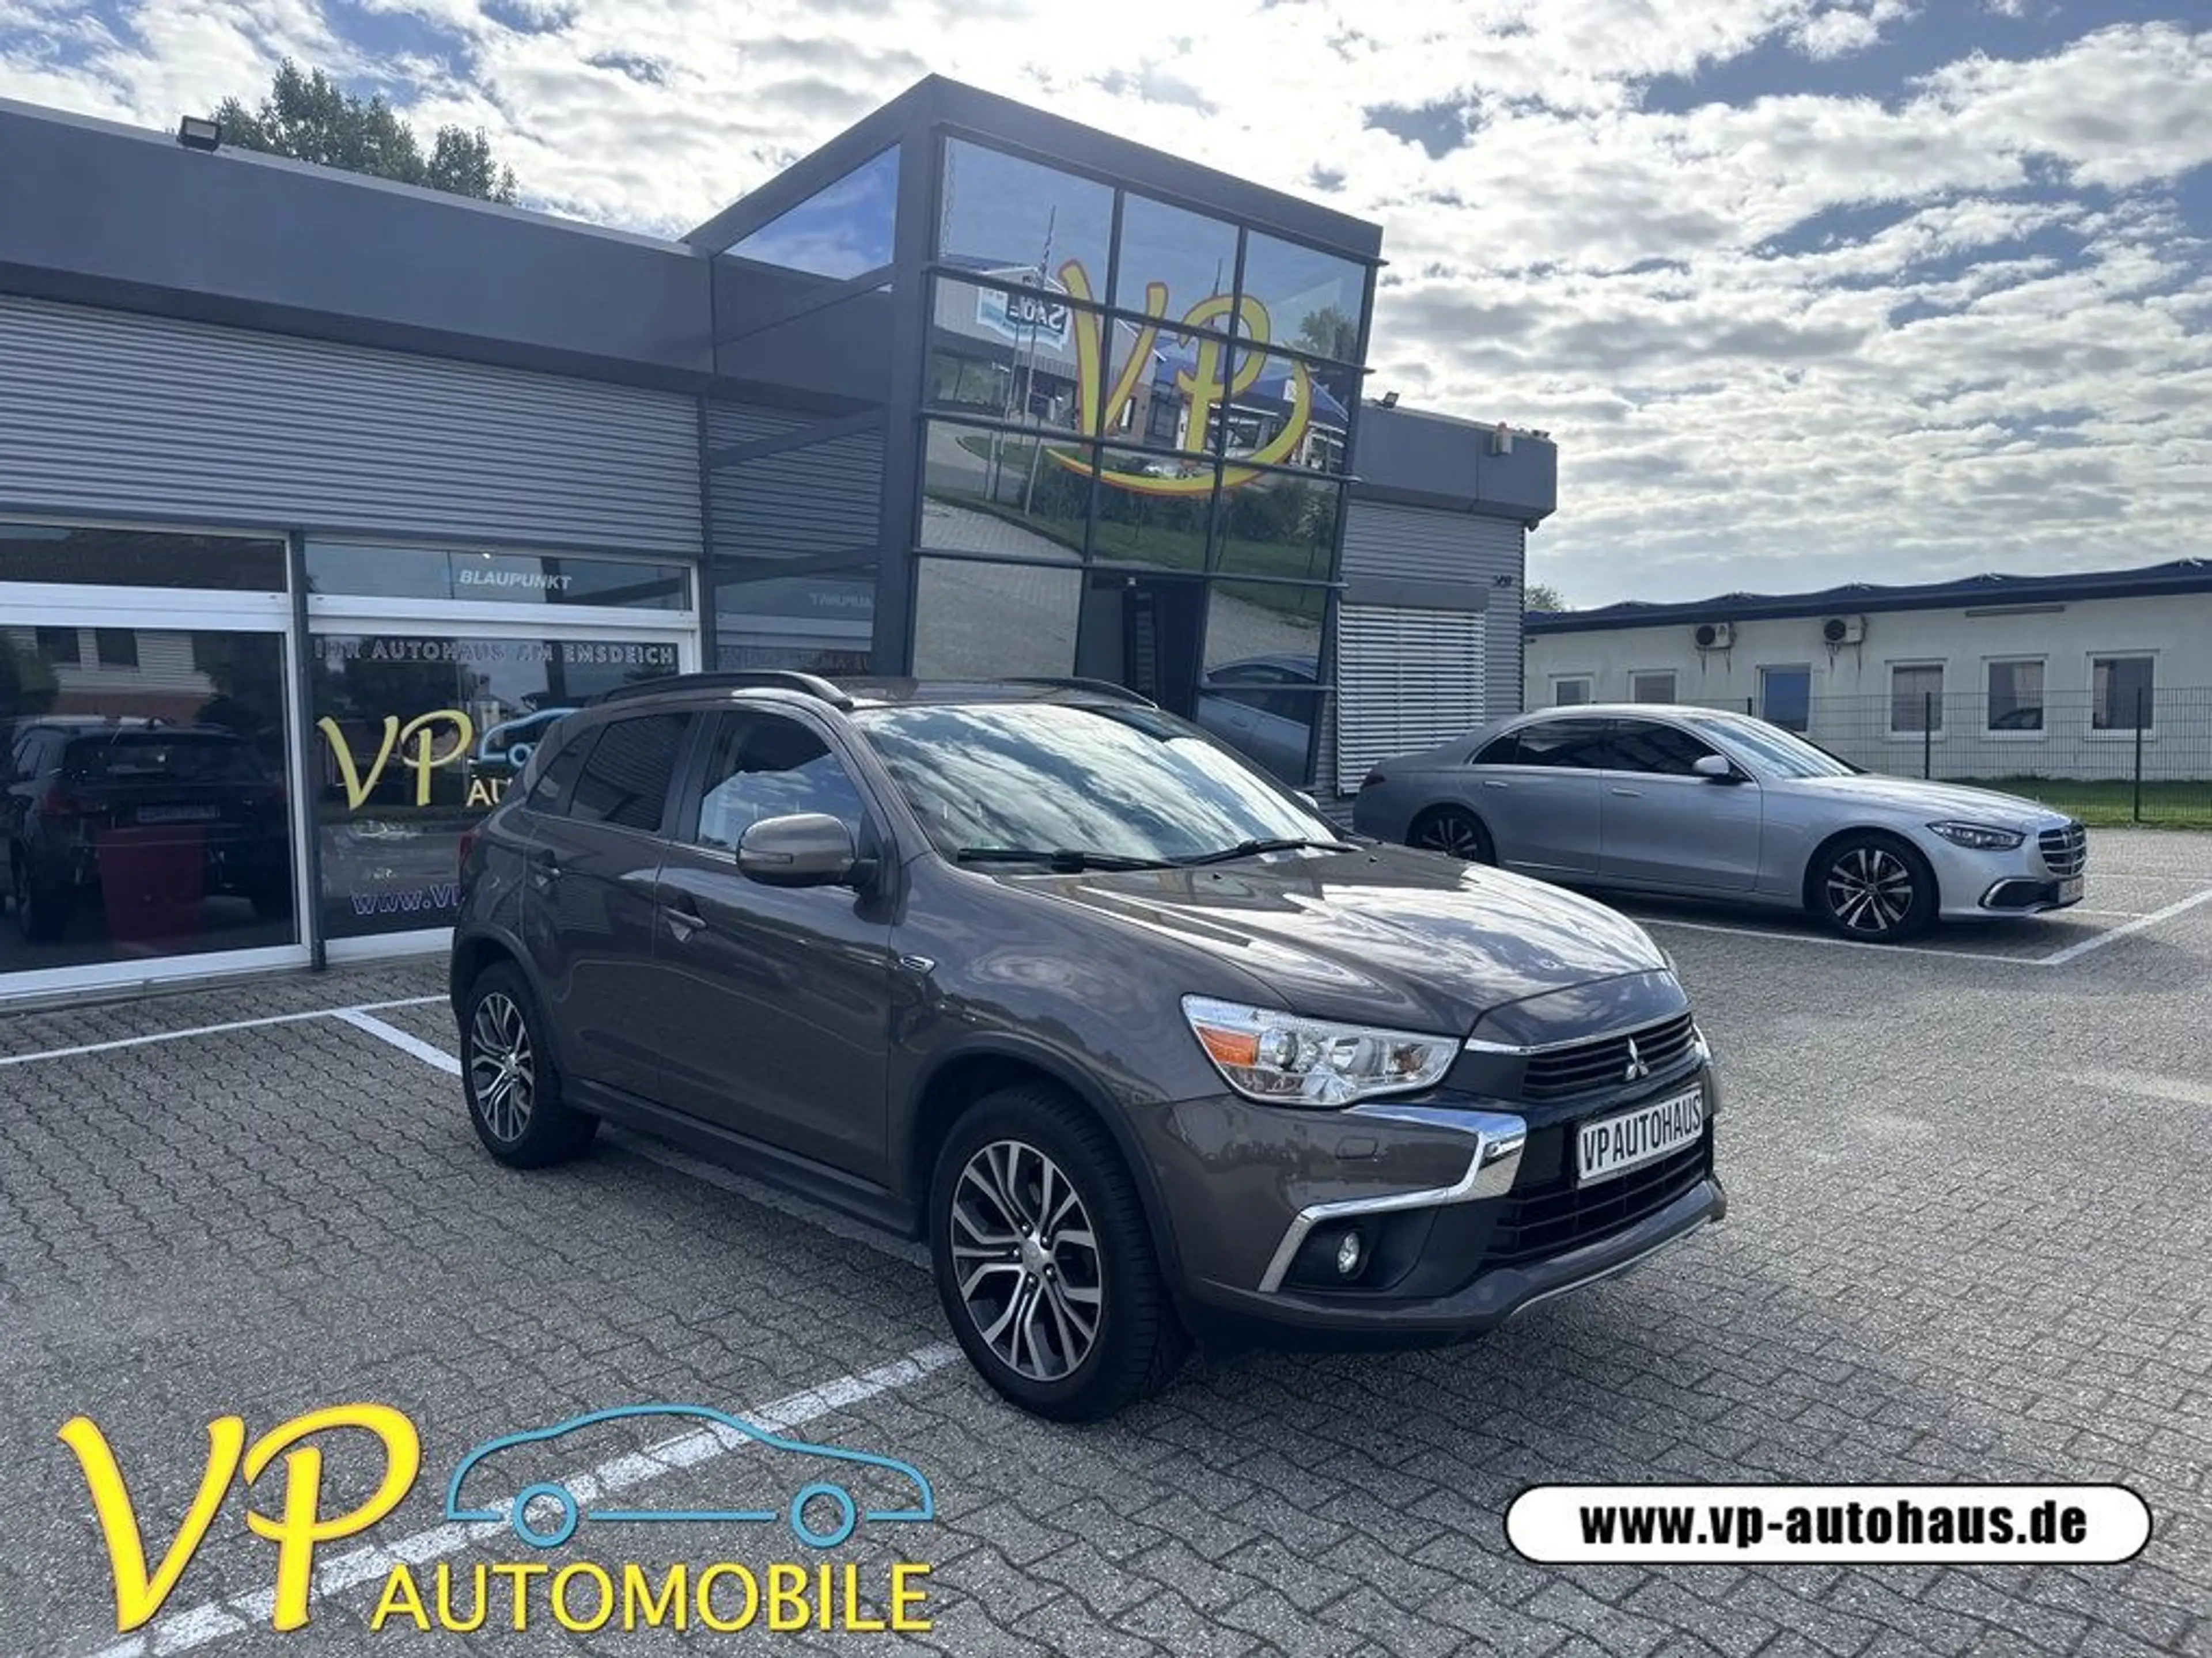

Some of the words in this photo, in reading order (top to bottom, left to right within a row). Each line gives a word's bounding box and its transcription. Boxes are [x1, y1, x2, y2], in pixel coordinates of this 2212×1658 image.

[1059, 259, 1271, 458] VP
[460, 569, 572, 589] BLAUPUNKT
[371, 639, 502, 661] AUTOHAUS
[517, 643, 553, 662] AM
[562, 643, 673, 664] EMSDEICH
[317, 709, 472, 810] VP
